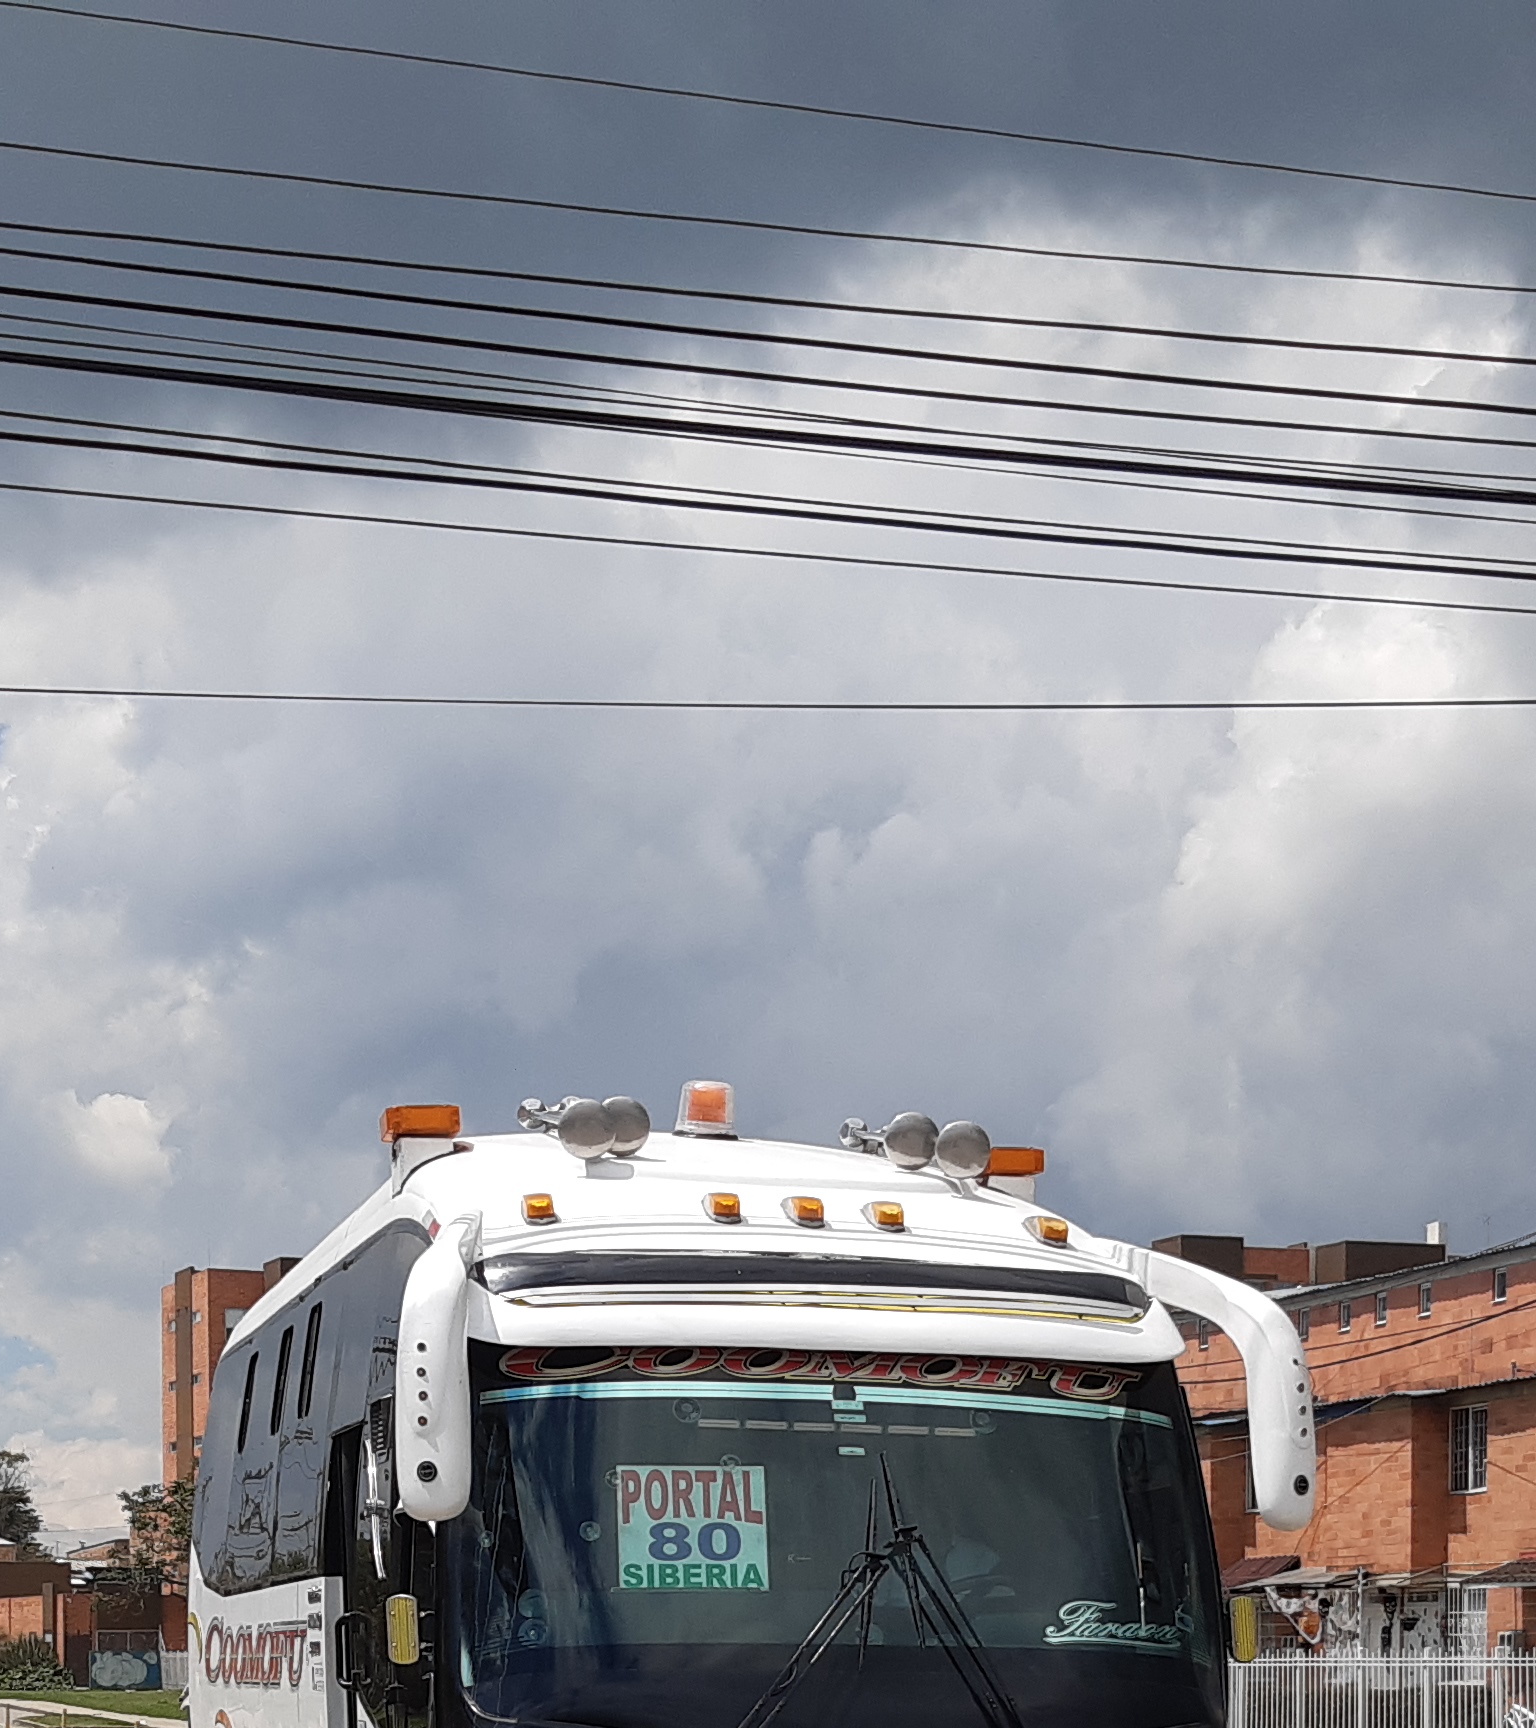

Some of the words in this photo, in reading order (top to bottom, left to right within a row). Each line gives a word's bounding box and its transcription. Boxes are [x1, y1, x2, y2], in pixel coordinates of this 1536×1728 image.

[620, 1469, 763, 1524] PORTAL
[648, 1522, 741, 1561] 80
[623, 1563, 764, 1588] SIBERIA
